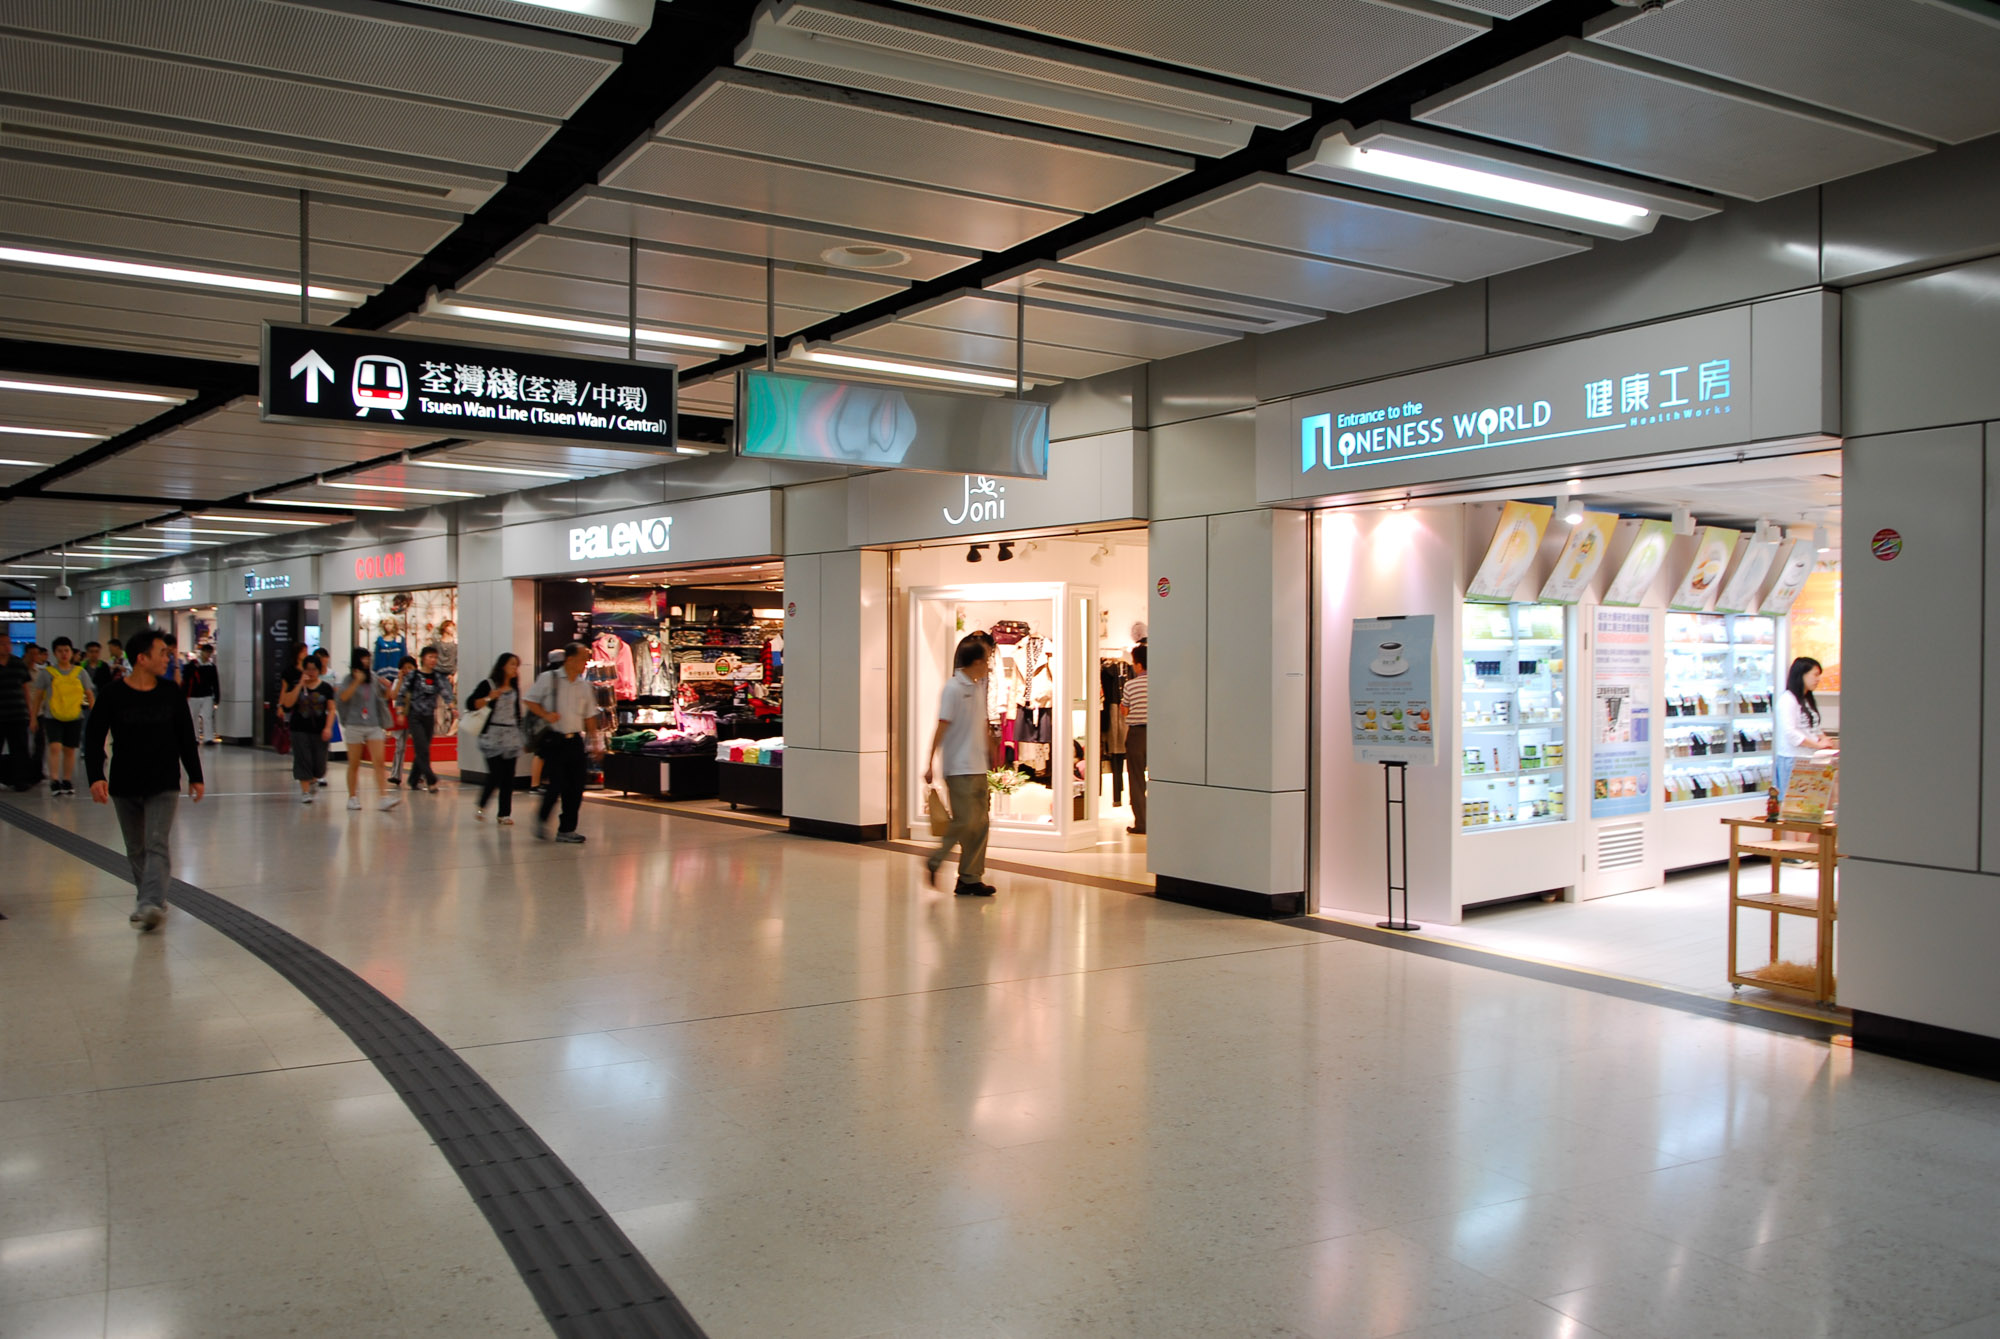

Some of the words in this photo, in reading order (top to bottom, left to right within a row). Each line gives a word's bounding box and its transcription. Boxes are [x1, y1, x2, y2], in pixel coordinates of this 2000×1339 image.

[1584, 359, 1730, 419] 健康工房
[419, 397, 462, 415] Tsuen
[463, 401, 496, 418] Wan
[498, 404, 528, 421] Line
[530, 407, 576, 426] (Tsuen
[577, 412, 607, 428] Wan
[608, 415, 616, 430] /
[617, 415, 667, 435] Central)
[1337, 409, 1385, 429] Entrance
[1387, 406, 1400, 420] to
[1402, 401, 1423, 417] the
[1337, 417, 1444, 457] ONENESS
[1452, 400, 1552, 439] WORLD
[355, 551, 406, 581] COLOR
